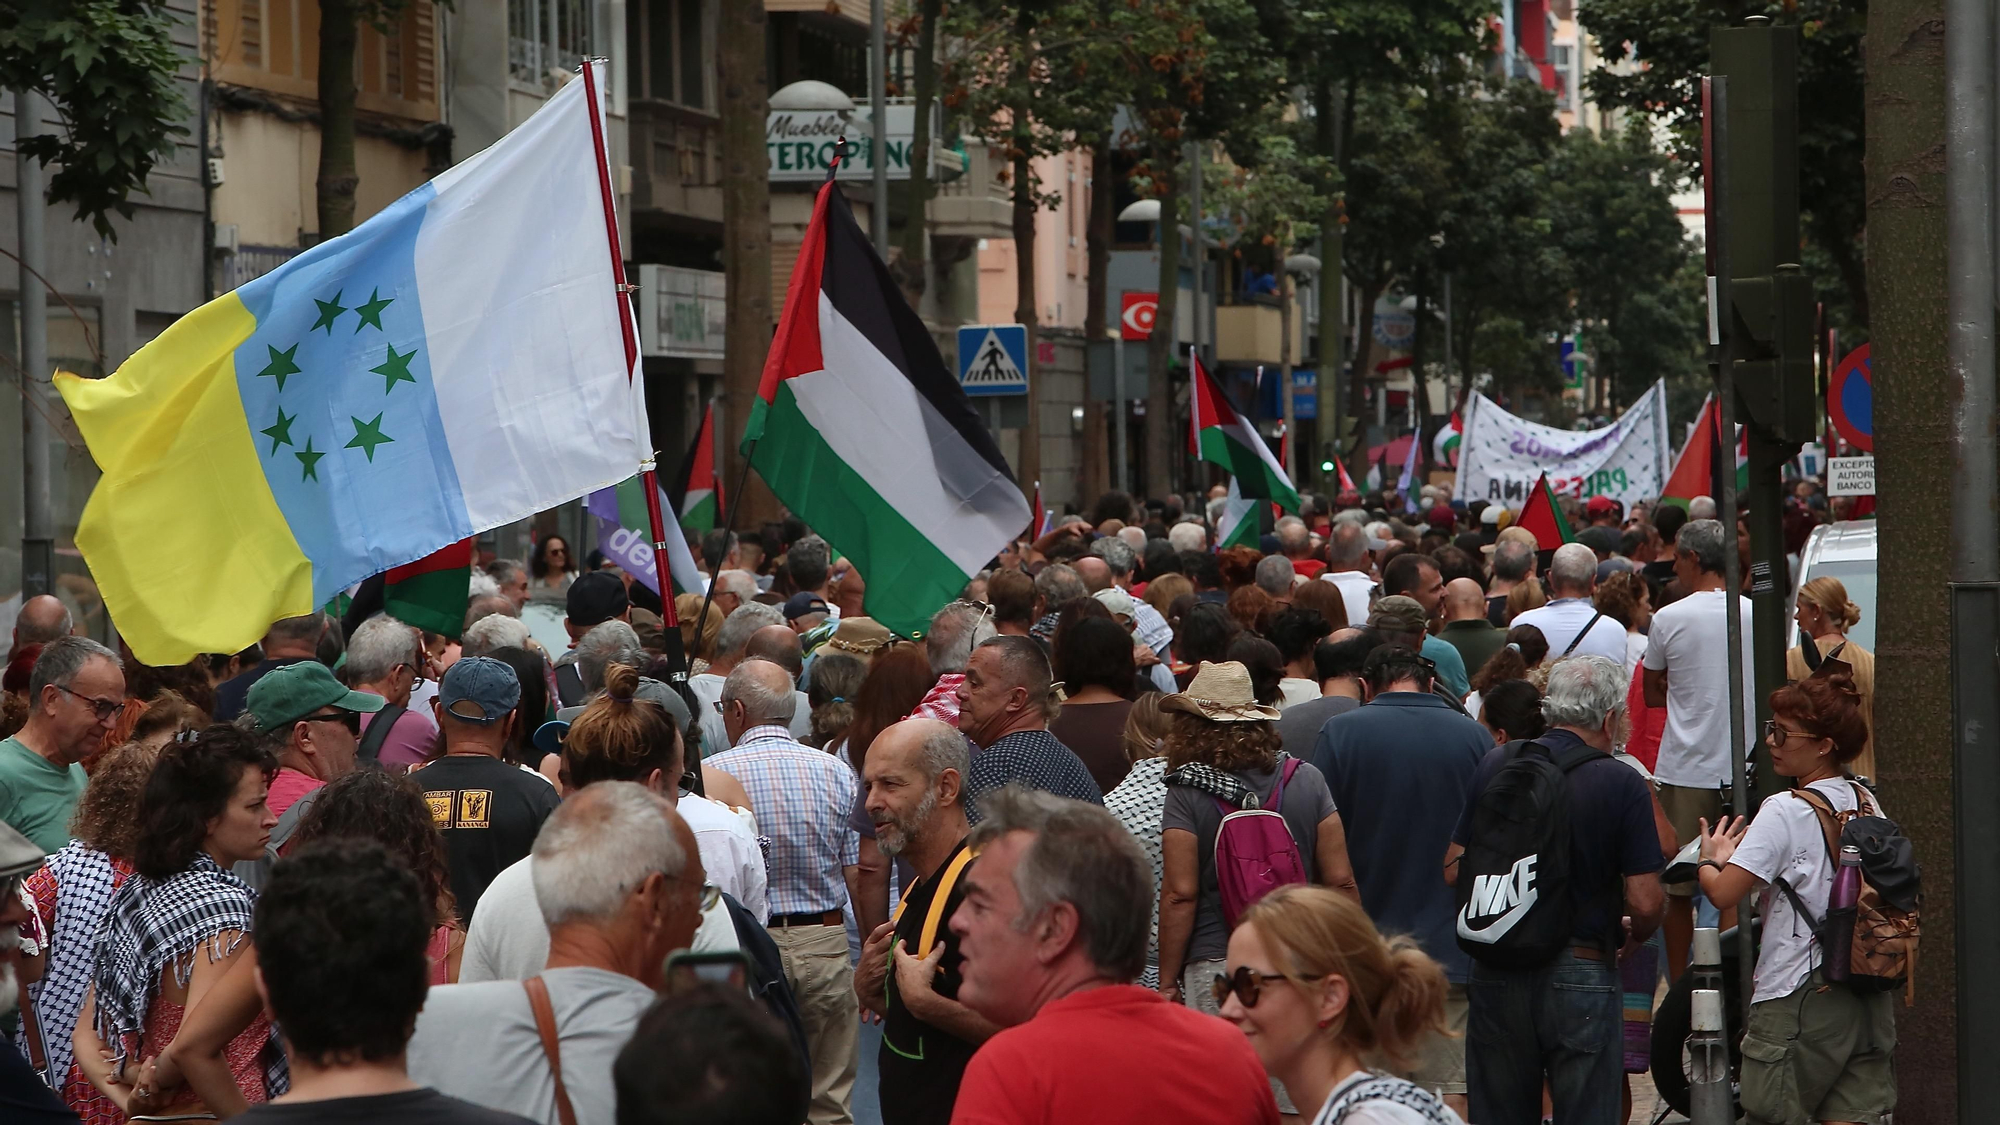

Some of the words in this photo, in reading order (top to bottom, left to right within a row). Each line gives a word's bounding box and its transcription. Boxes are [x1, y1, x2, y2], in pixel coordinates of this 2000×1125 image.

[1838, 470, 1875, 479] AUTORI
[1837, 481, 1872, 490] BANCO
[1467, 854, 1538, 919] NIKE
